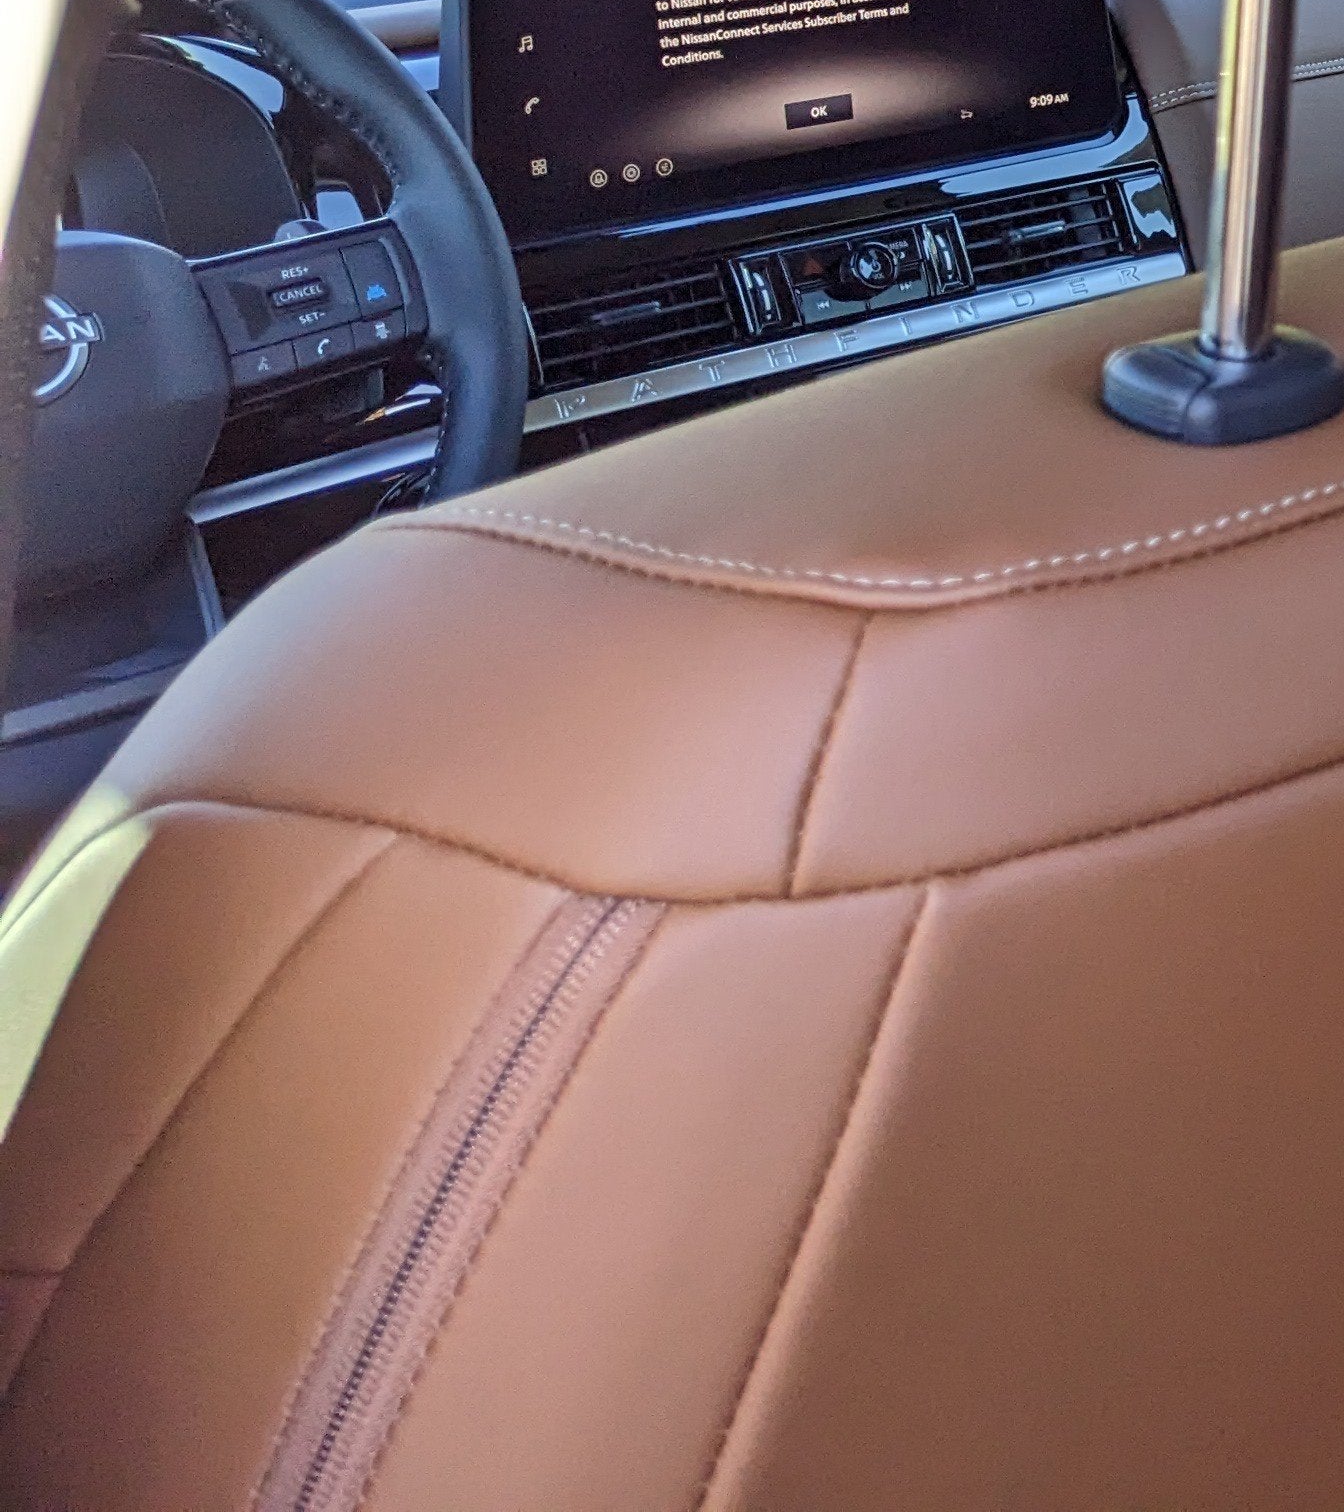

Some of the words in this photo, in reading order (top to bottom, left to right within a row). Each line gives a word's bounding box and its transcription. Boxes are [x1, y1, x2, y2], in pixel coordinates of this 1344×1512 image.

[655, 0, 669, 11] to
[658, 13, 702, 30] internal
[703, 10, 725, 24] and
[726, 2, 787, 20] commercial
[659, 36, 680, 49] the
[680, 25, 761, 45] NissanConnect
[761, 19, 803, 35] Services
[803, 12, 858, 28] Subscriber
[858, 7, 889, 20] Terms
[889, 2, 910, 16] and
[661, 50, 725, 67] Conditions.
[1028, 93, 1054, 109] 9:09
[1054, 92, 1070, 105] AM
[810, 105, 828, 118] OK
[280, 266, 310, 280] RES+
[279, 284, 322, 303] CANCEL
[299, 311, 326, 325] SET-
[555, 265, 1142, 421] PATHFINDER
